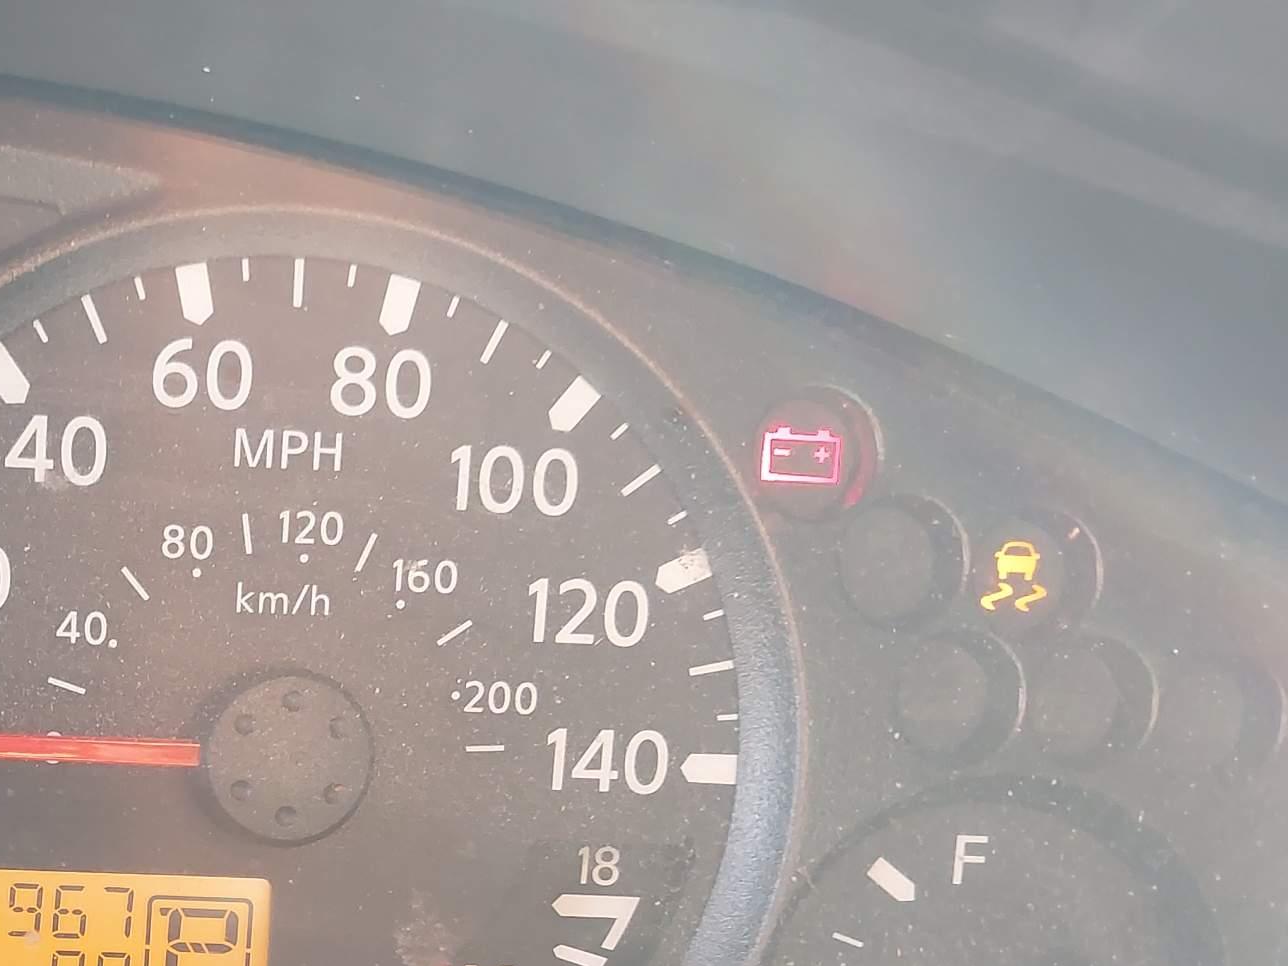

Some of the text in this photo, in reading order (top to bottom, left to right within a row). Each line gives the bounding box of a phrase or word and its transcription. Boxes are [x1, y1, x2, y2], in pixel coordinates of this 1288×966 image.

[152, 339, 253, 410] 60
[330, 347, 431, 418] 80
[4, 415, 107, 486] 40
[234, 430, 344, 472] MPH
[452, 445, 578, 517] 100
[162, 525, 214, 561] 80
[279, 510, 344, 548] 120
[392, 557, 458, 595] 160
[236, 584, 330, 619] km/h
[527, 580, 648, 649] 120
[56, 611, 106, 646] 40
[463, 682, 538, 716] 200
[546, 728, 669, 795] 140
[578, 847, 618, 885] 18
[952, 836, 989, 884] F
